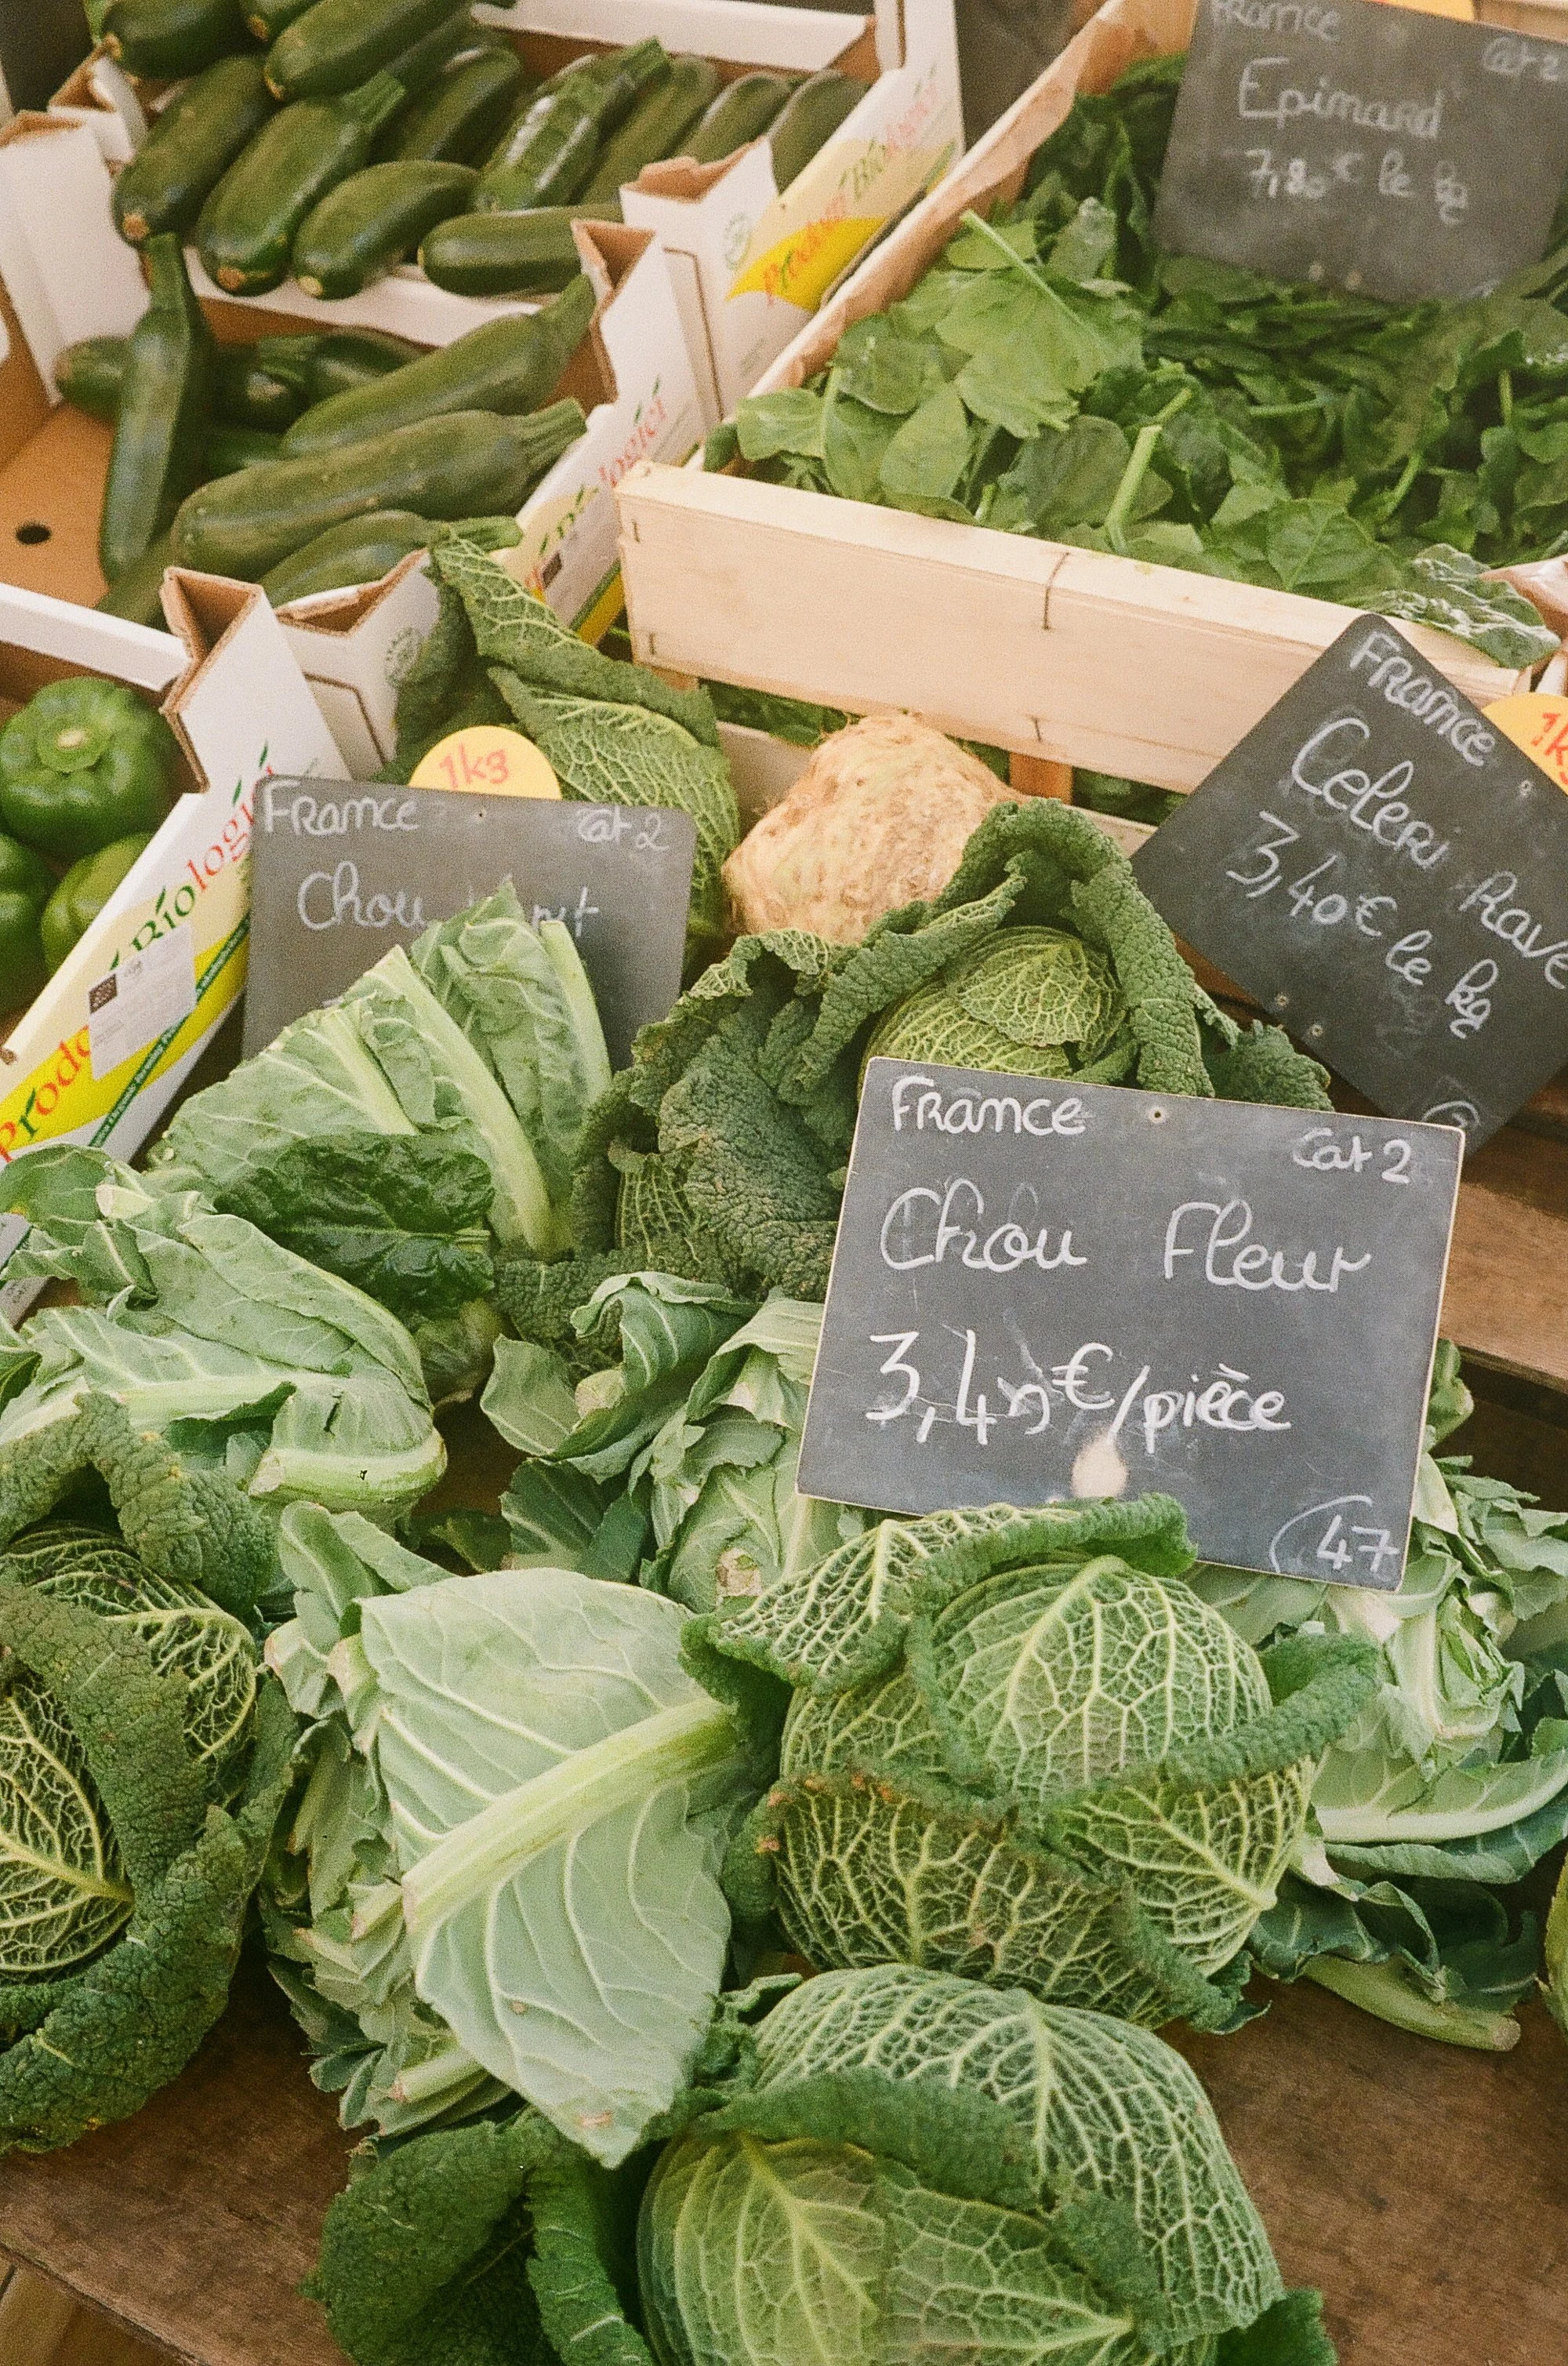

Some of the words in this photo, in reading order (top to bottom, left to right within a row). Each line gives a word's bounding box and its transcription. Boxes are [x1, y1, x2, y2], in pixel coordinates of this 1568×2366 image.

[439, 743, 510, 789] 1kg
[263, 780, 419, 837] France
[635, 812, 669, 851] 2
[297, 861, 428, 932] Chou
[1385, 930, 1432, 986] le
[1445, 958, 1499, 1039] kg
[891, 1074, 1088, 1136] France
[1293, 1127, 1373, 1172] Cat
[1381, 1139, 1411, 1184] 2
[880, 1178, 1087, 1273] Chou
[1164, 1199, 1373, 1292] Fleur
[1316, 1514, 1399, 1573] 47
